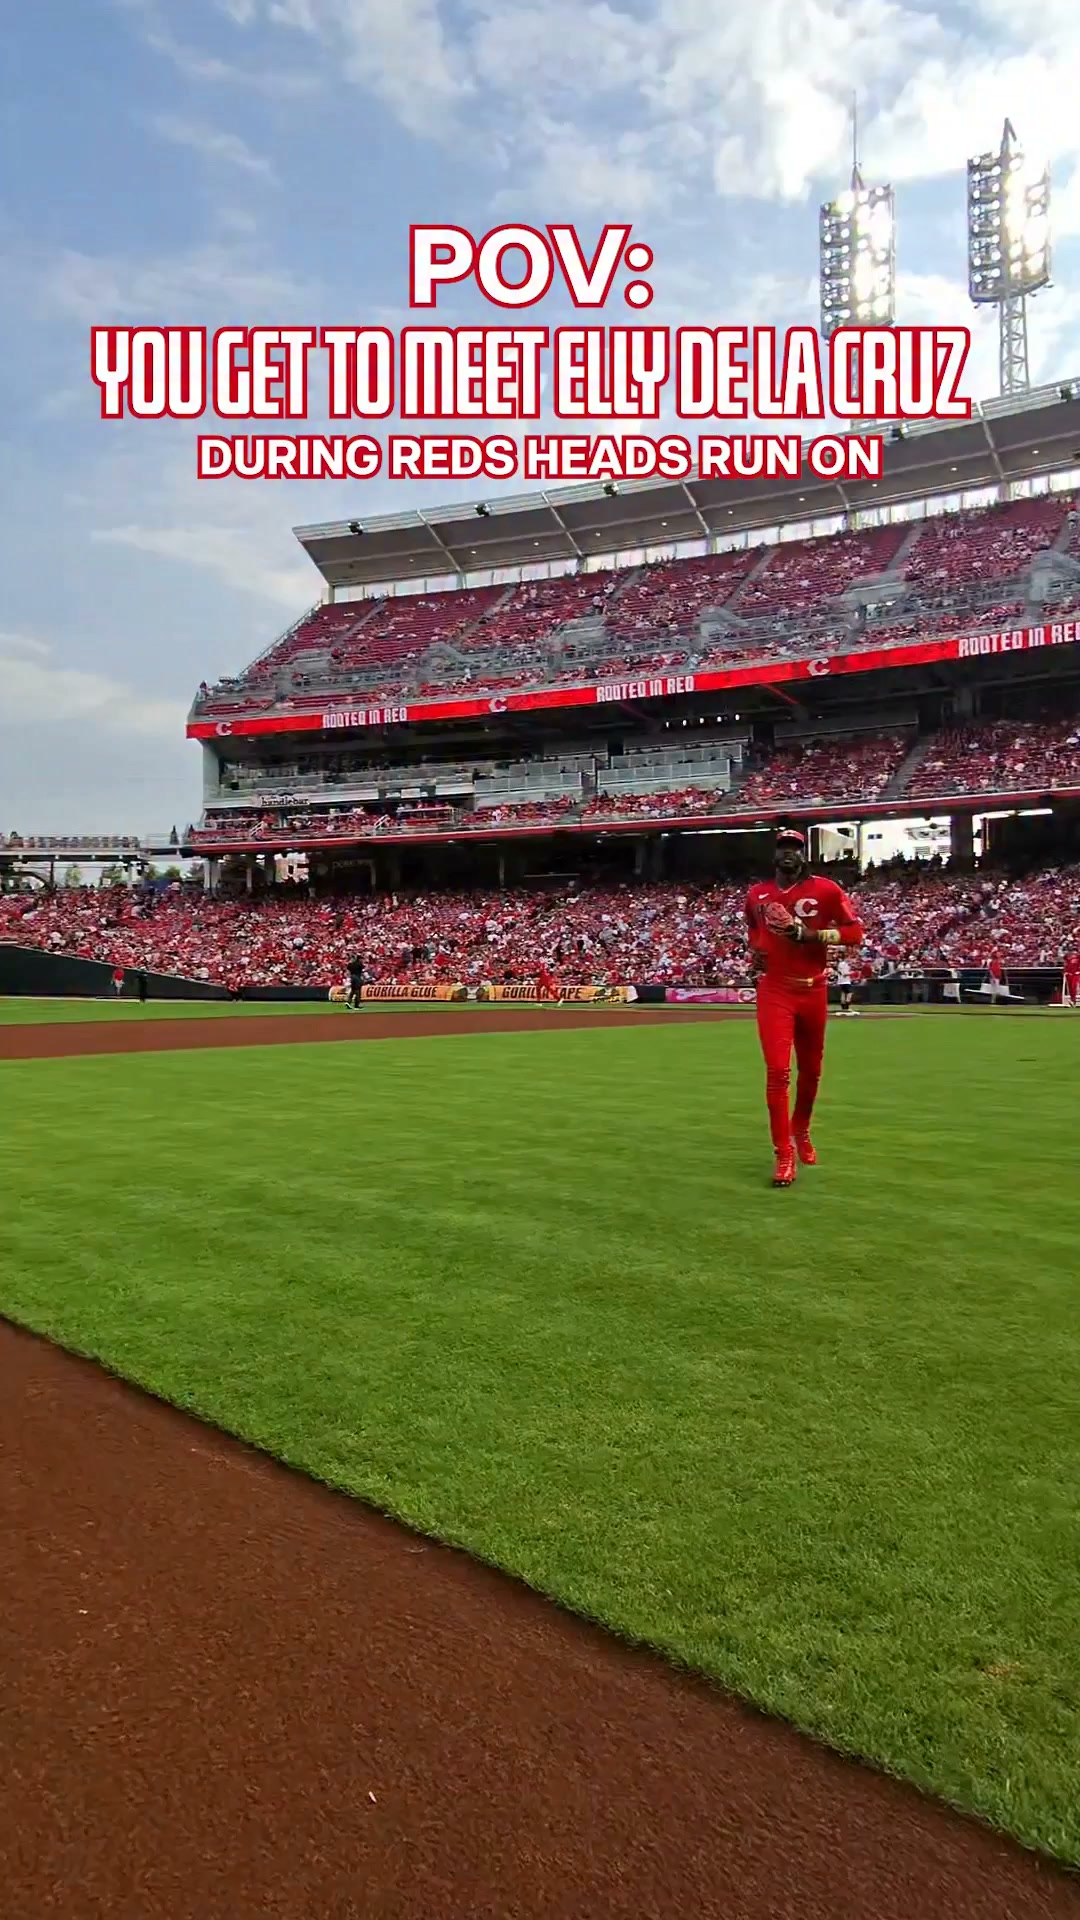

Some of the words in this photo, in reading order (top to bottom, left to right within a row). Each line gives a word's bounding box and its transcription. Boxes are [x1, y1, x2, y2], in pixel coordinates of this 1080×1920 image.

[958, 630, 1023, 658] ROOTED
[1028, 627, 1045, 648] IN
[597, 683, 647, 703] ROOTED
[650, 680, 663, 697] IN
[667, 675, 694, 694] RED
[322, 711, 366, 729] ROOTED
[369, 709, 380, 725] IN
[384, 707, 407, 723] RED
[794, 898, 818, 917] C
[366, 986, 409, 998] GORILLA
[411, 986, 437, 998] GLUE
[502, 986, 549, 999] GORILA
